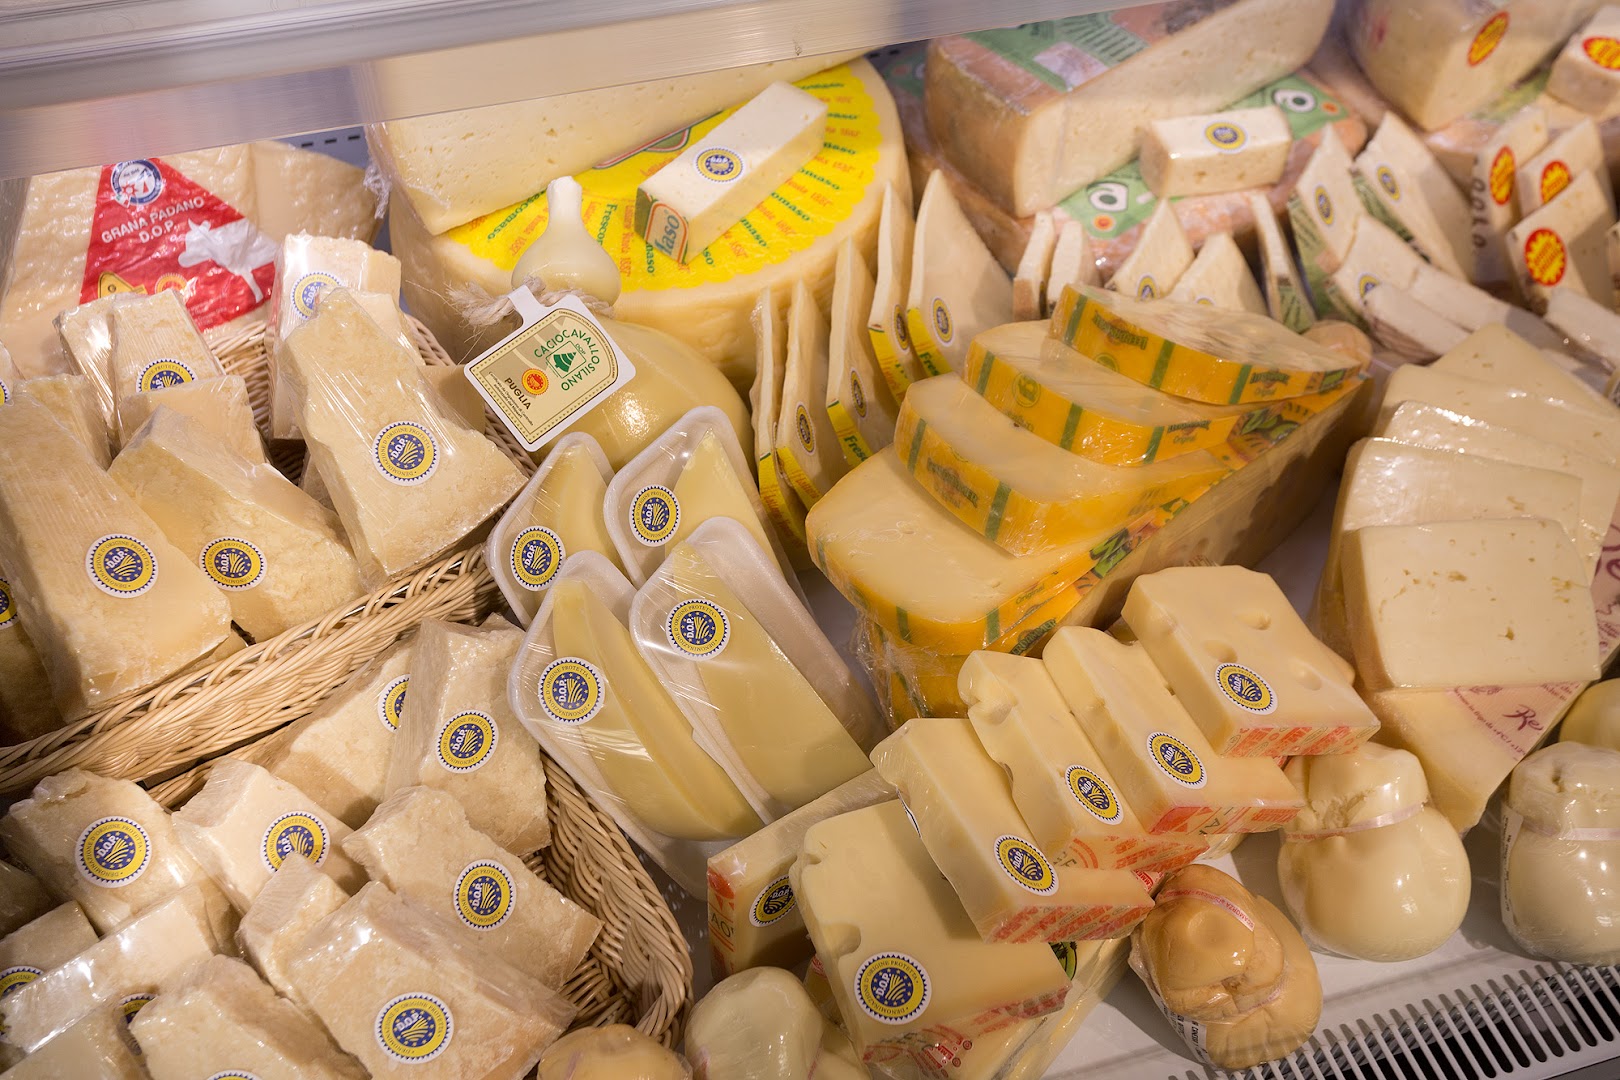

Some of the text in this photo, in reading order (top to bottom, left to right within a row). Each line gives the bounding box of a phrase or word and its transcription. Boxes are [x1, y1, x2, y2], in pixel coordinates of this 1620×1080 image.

[101, 196, 205, 244] GRANA PADANO
[534, 328, 600, 391] CACIOCAVALLO SILANO
[505, 377, 531, 410] PUGLIA
[391, 439, 408, 458] D.O.P.
[646, 504, 654, 524] D.O.P.
[107, 551, 128, 568] D.O.P.
[221, 553, 229, 572] D.O.P.
[525, 545, 536, 565] D.O.P.
[688, 605, 715, 615] PROTETTA
[561, 665, 589, 679] PROTETTA
[559, 679, 567, 702] D.O.P.
[468, 717, 488, 731] PROTETTA
[453, 730, 467, 750] D.O.P.
[1166, 747, 1174, 762] D.O.P.
[97, 835, 119, 856] D.O.P.
[121, 825, 143, 848] PROTETTA
[1014, 849, 1024, 868] D.O.P.
[474, 883, 482, 906] D.O.P.
[1220, 901, 1256, 929] SCAMORZA
[890, 961, 918, 980] PROTETTA
[877, 972, 891, 996] D.O.P.
[396, 1012, 422, 1032] D.O.P.
